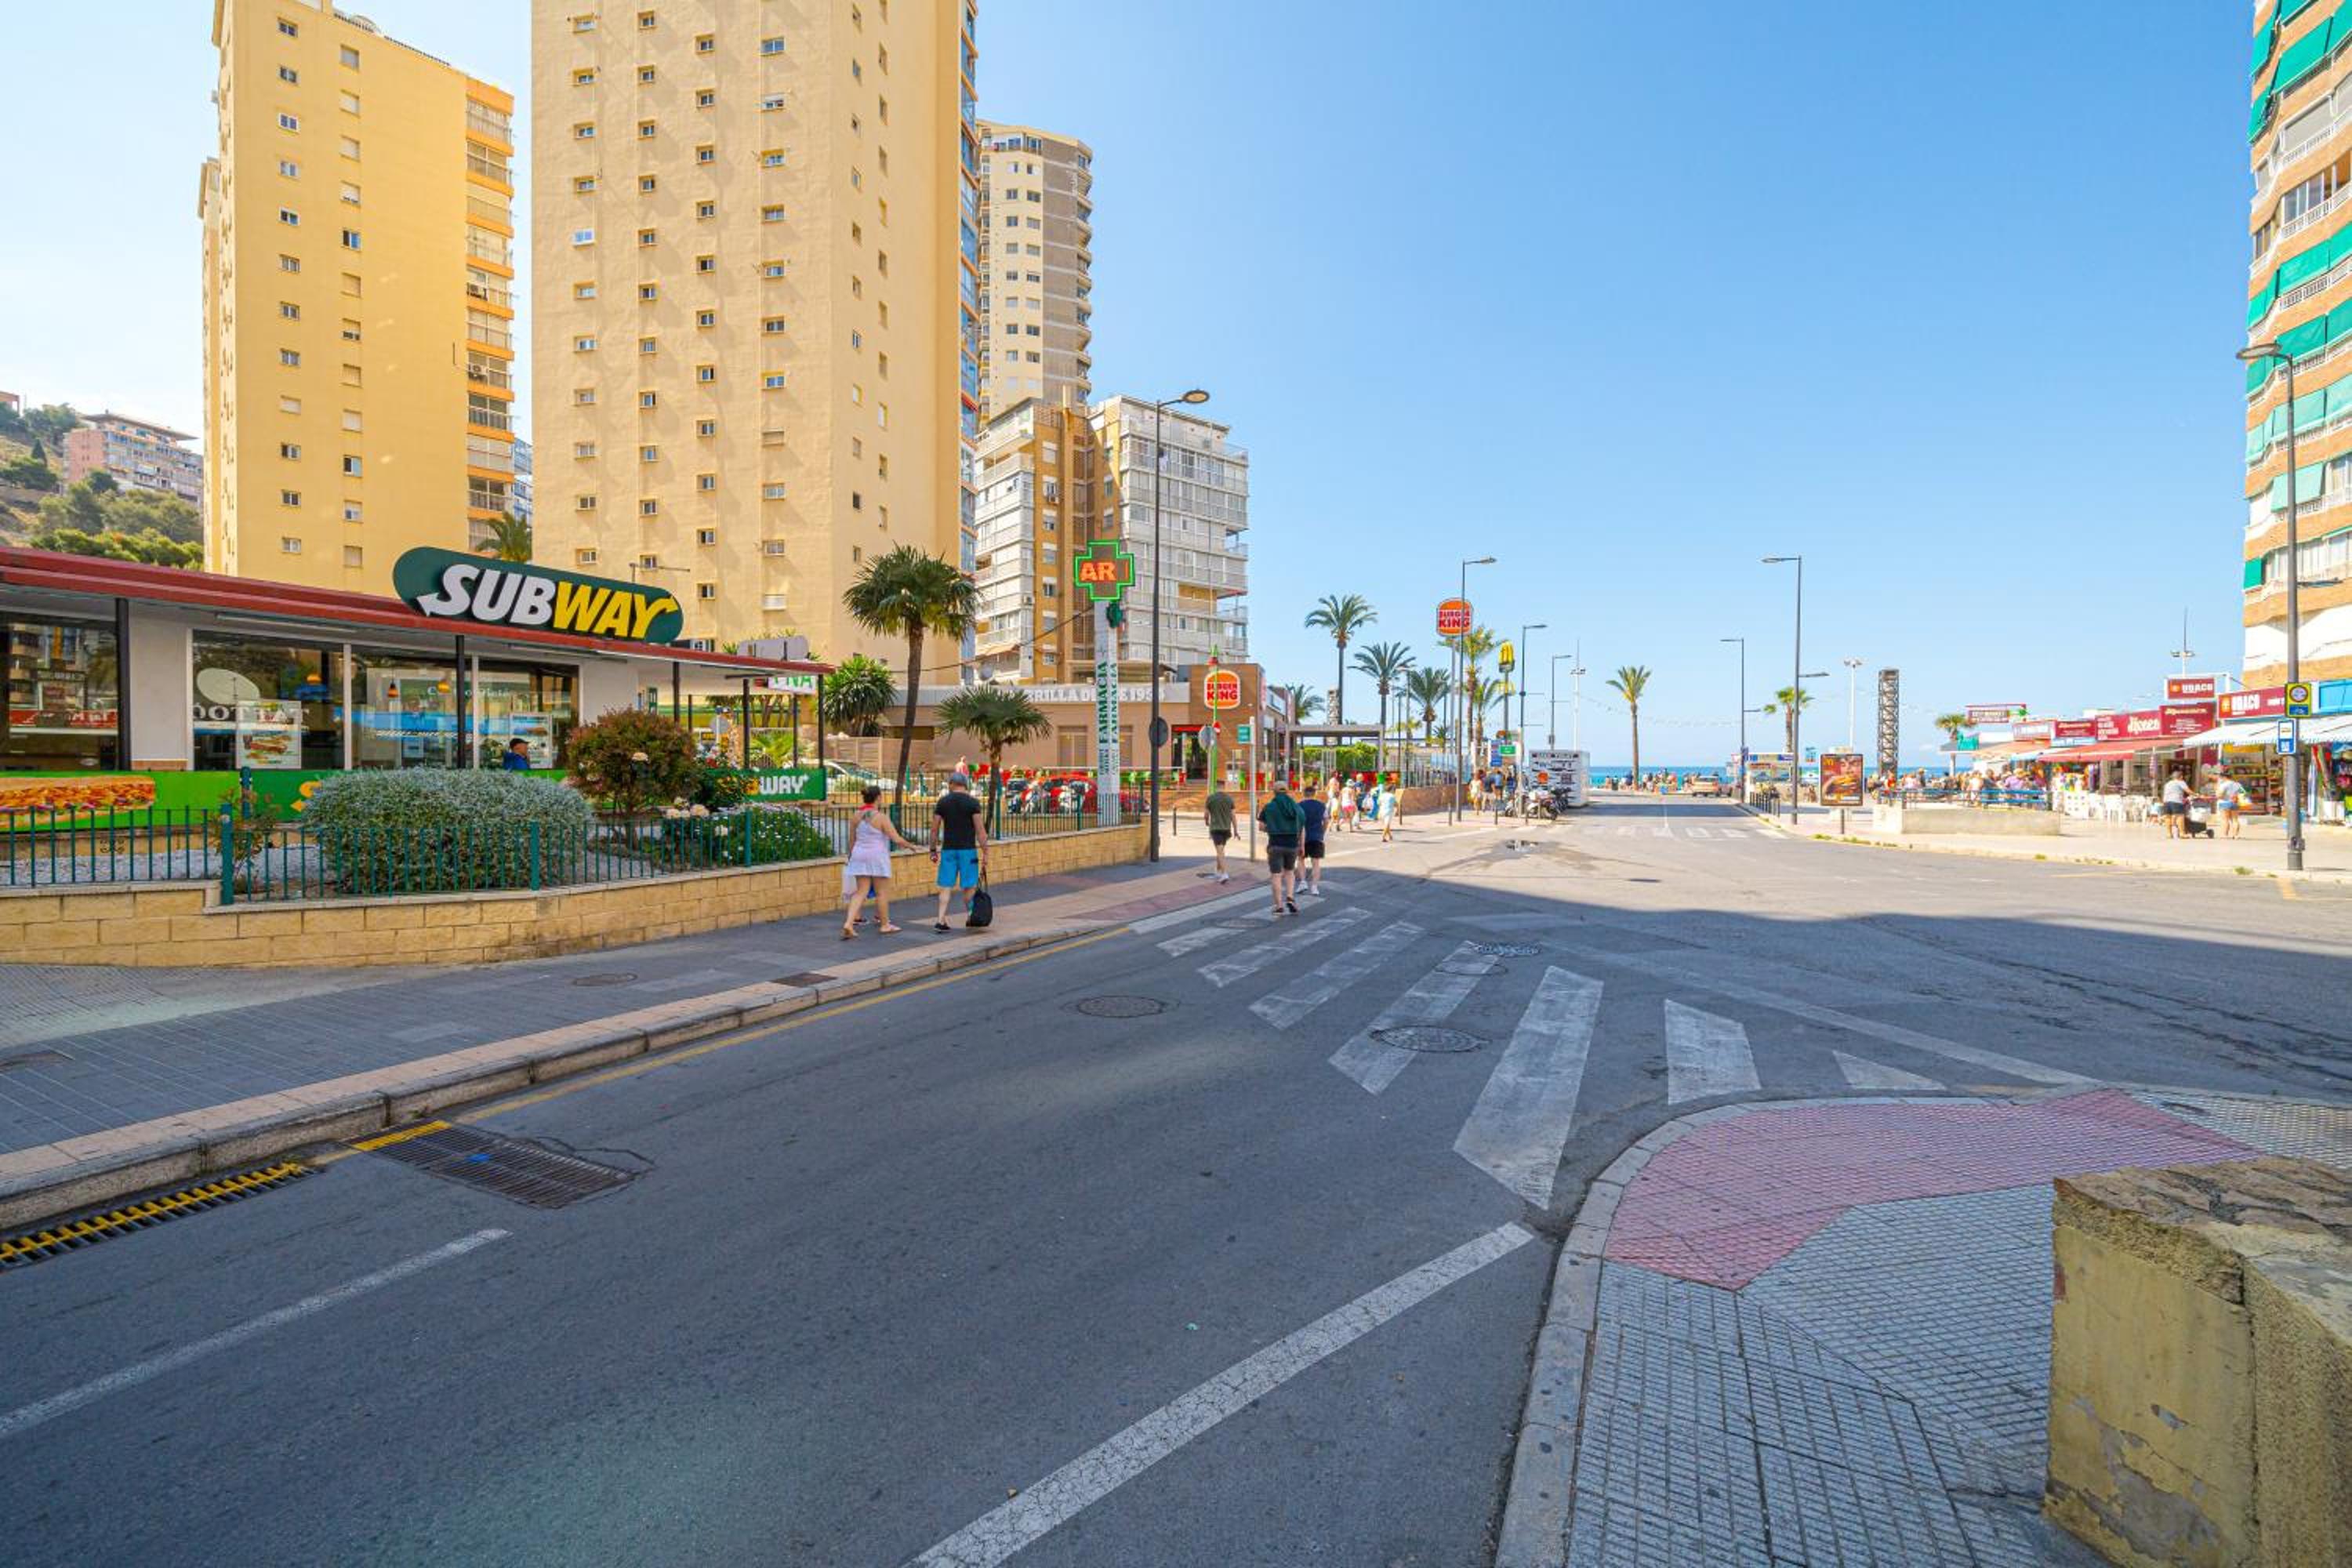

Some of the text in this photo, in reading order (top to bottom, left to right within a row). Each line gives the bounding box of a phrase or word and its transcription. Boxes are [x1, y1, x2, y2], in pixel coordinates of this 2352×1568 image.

[416, 563, 677, 639] SUBWAY
[1439, 618, 1470, 627] KING
[1081, 688, 1127, 702] DEE
[1207, 691, 1238, 700] KING
[1098, 662, 1108, 743] FARMACIA
